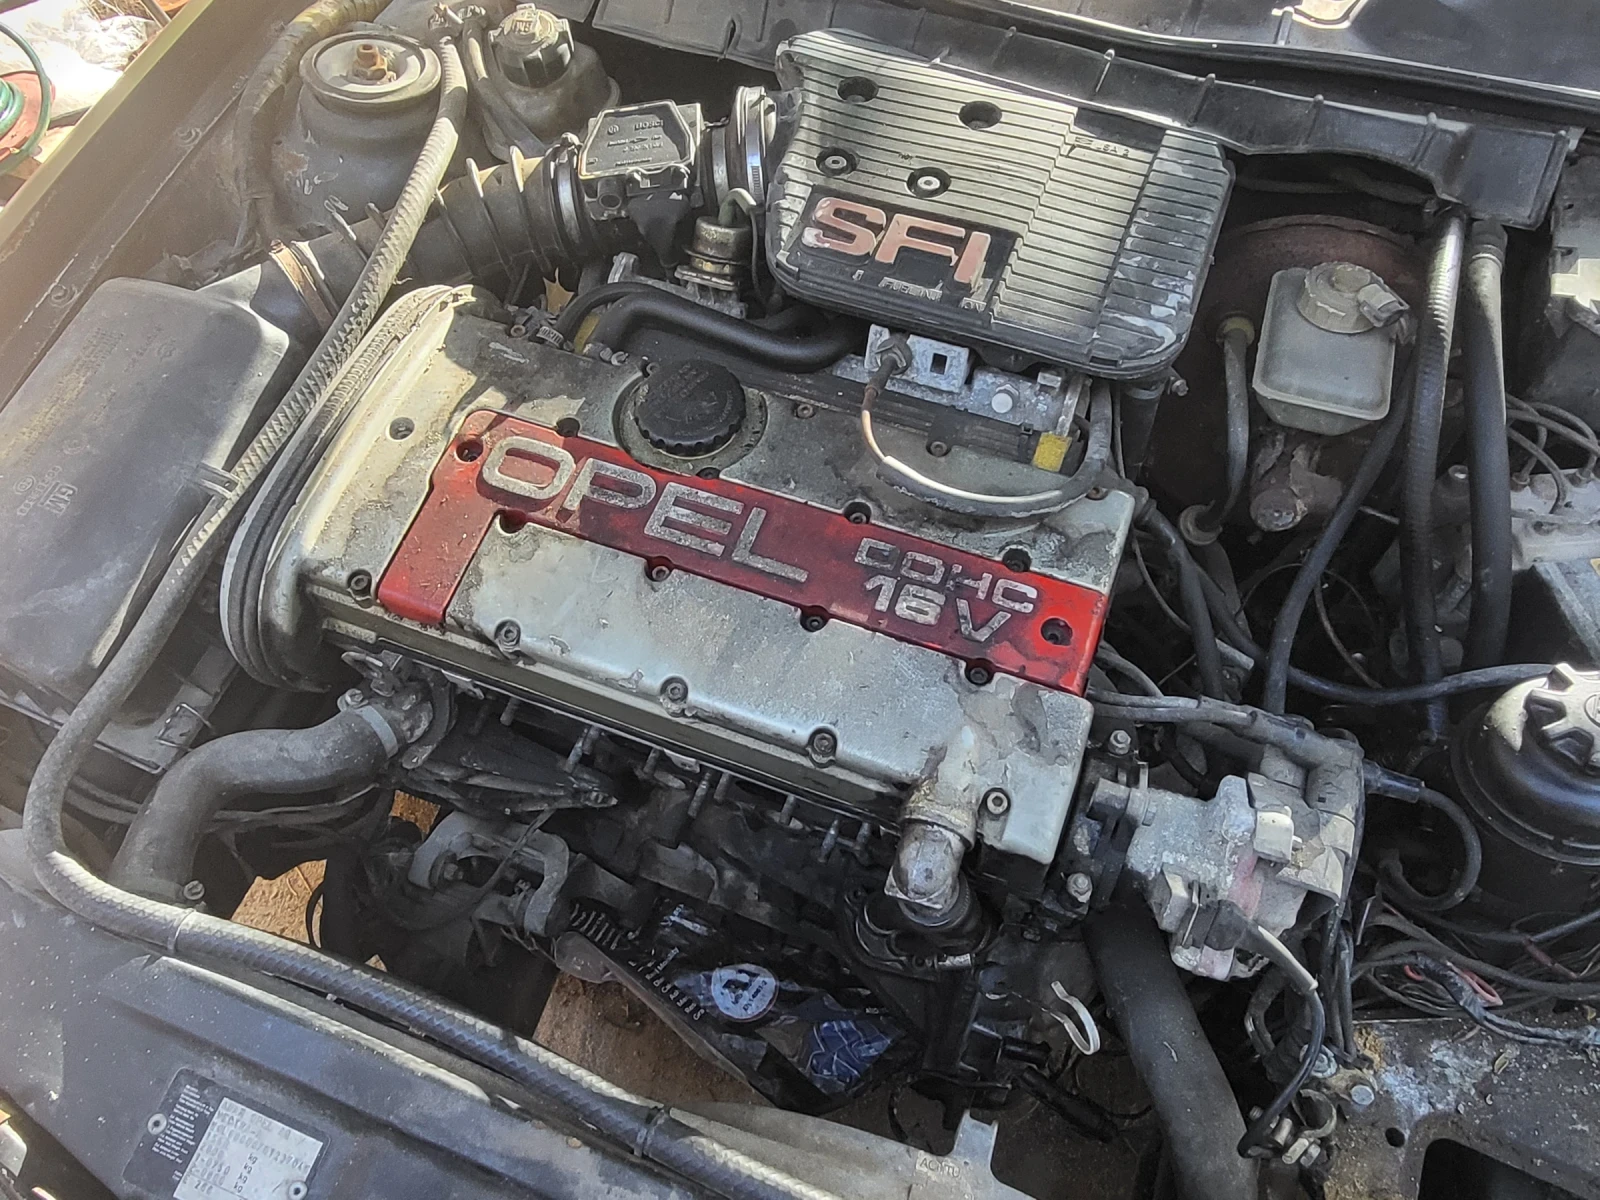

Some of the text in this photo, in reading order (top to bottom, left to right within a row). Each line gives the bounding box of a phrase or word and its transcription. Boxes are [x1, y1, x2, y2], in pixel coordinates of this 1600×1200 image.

[801, 196, 991, 285] SFI
[45, 483, 78, 518] GM
[482, 436, 809, 584] OPEL
[854, 537, 1039, 614] DOHC
[243, 1162, 253, 1174] kg
[247, 1153, 258, 1165] kg
